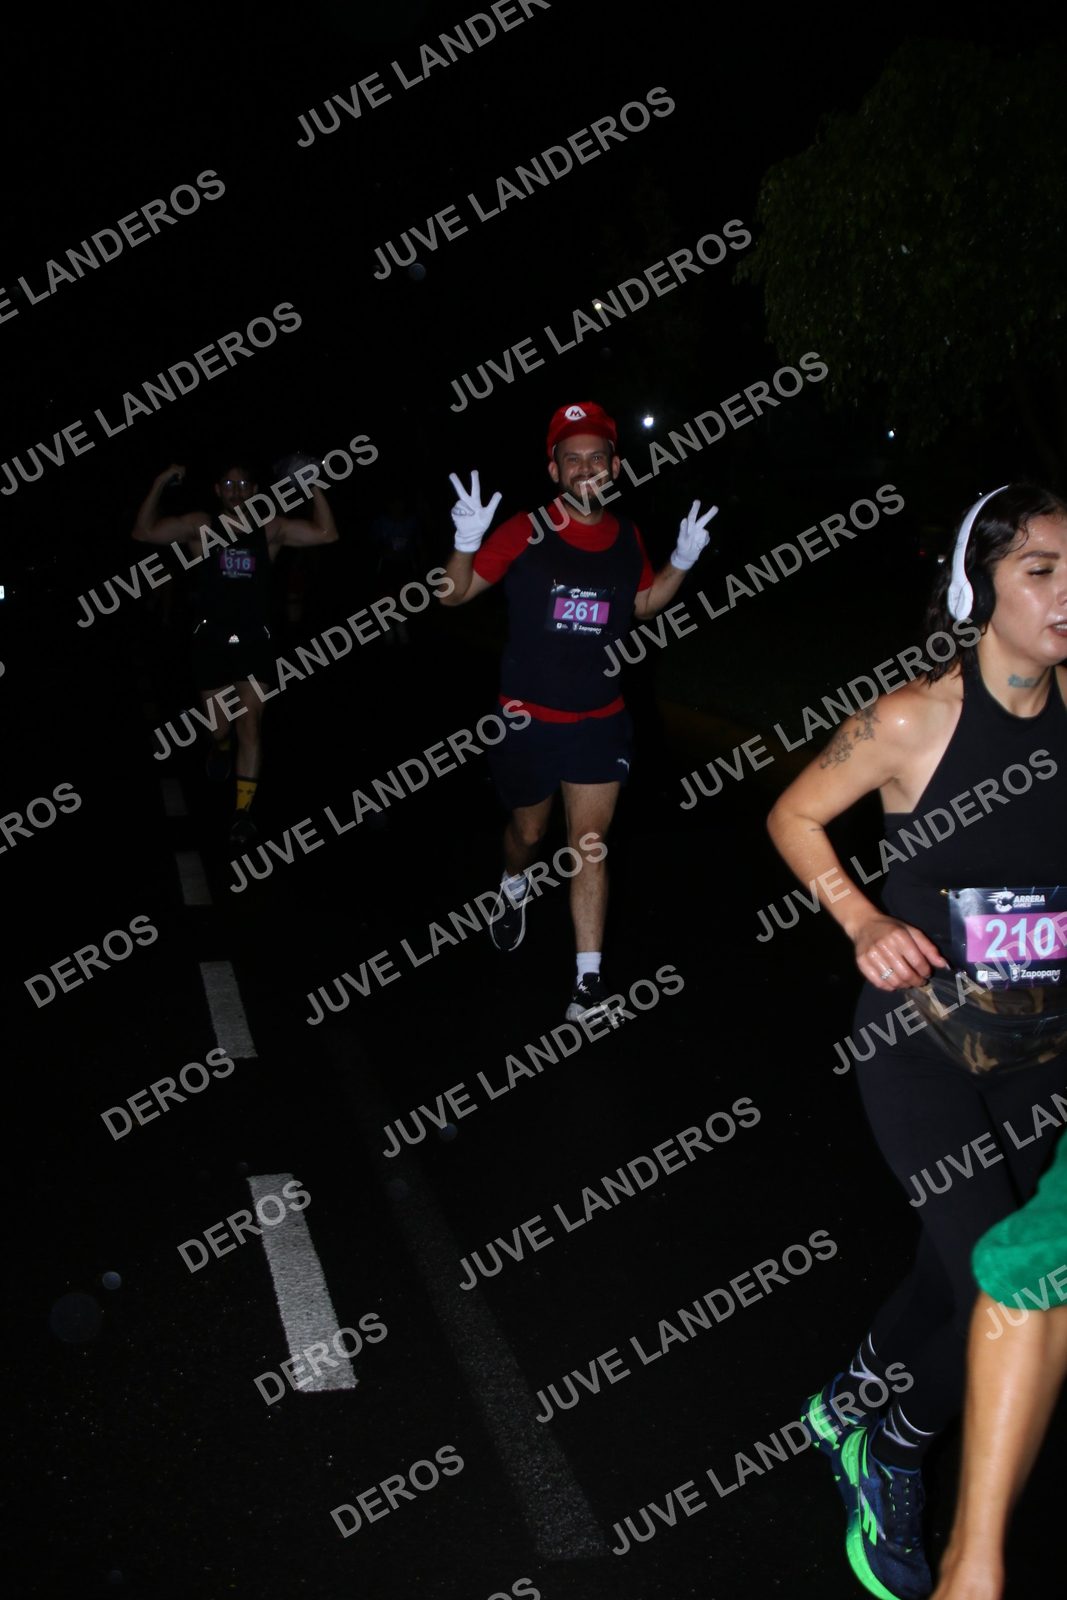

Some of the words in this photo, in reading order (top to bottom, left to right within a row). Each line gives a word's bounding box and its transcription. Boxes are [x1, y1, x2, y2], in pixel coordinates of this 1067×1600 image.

[562, 600, 599, 622] 261
[985, 917, 1055, 959] 210
[1020, 969, 1061, 981] Zapopan
